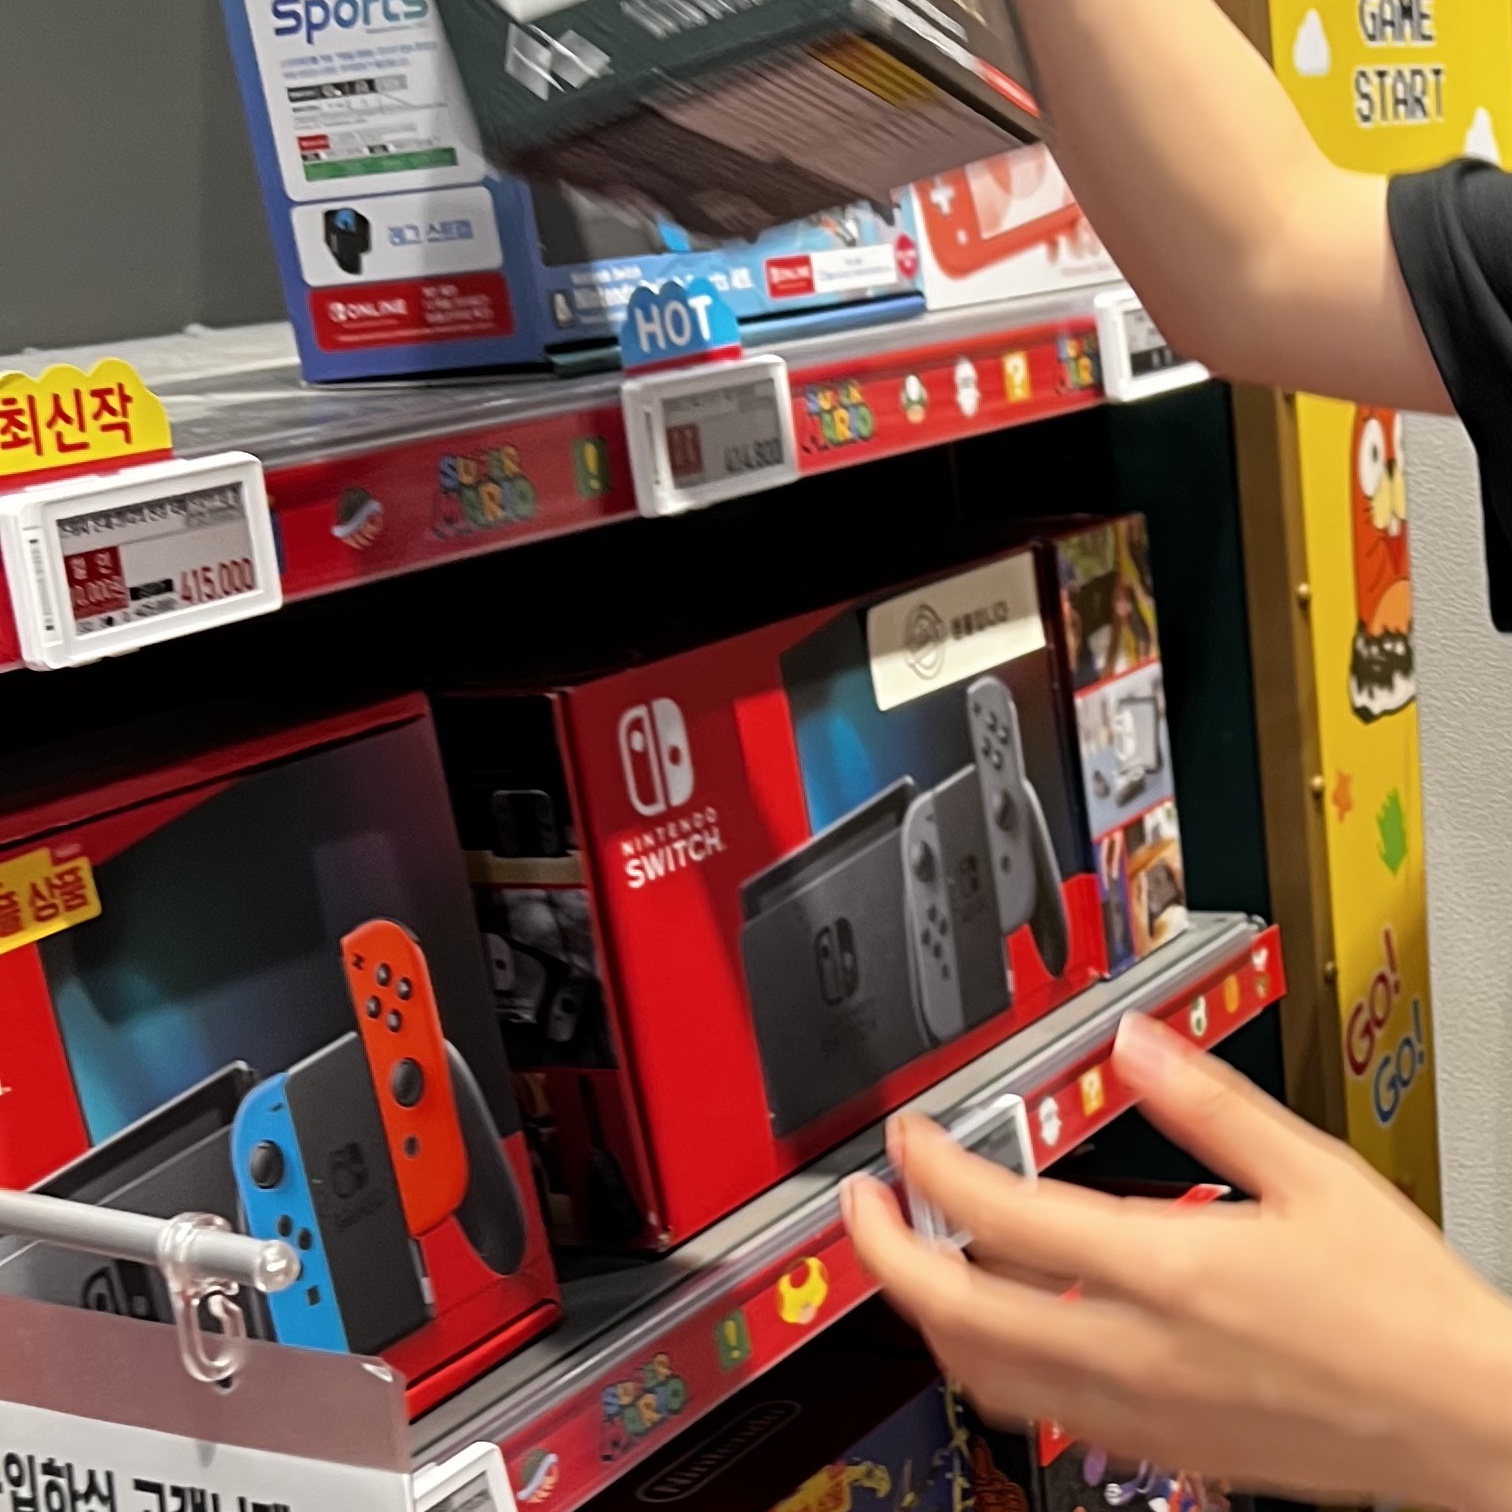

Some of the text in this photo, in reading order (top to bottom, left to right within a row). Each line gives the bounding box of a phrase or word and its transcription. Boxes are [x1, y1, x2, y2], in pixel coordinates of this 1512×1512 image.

[1357, 0, 1434, 42] GAME
[1354, 67, 1444, 123] START
[633, 293, 713, 353] HOT
[0, 381, 134, 457] 최신작
[621, 805, 718, 857] NINTENDO
[624, 825, 722, 889] SWITCH
[29, 865, 88, 922] 상품
[1345, 927, 1401, 1077] GO!
[1373, 998, 1425, 1124] GO!
[652, 1408, 786, 1494] Nintendo
